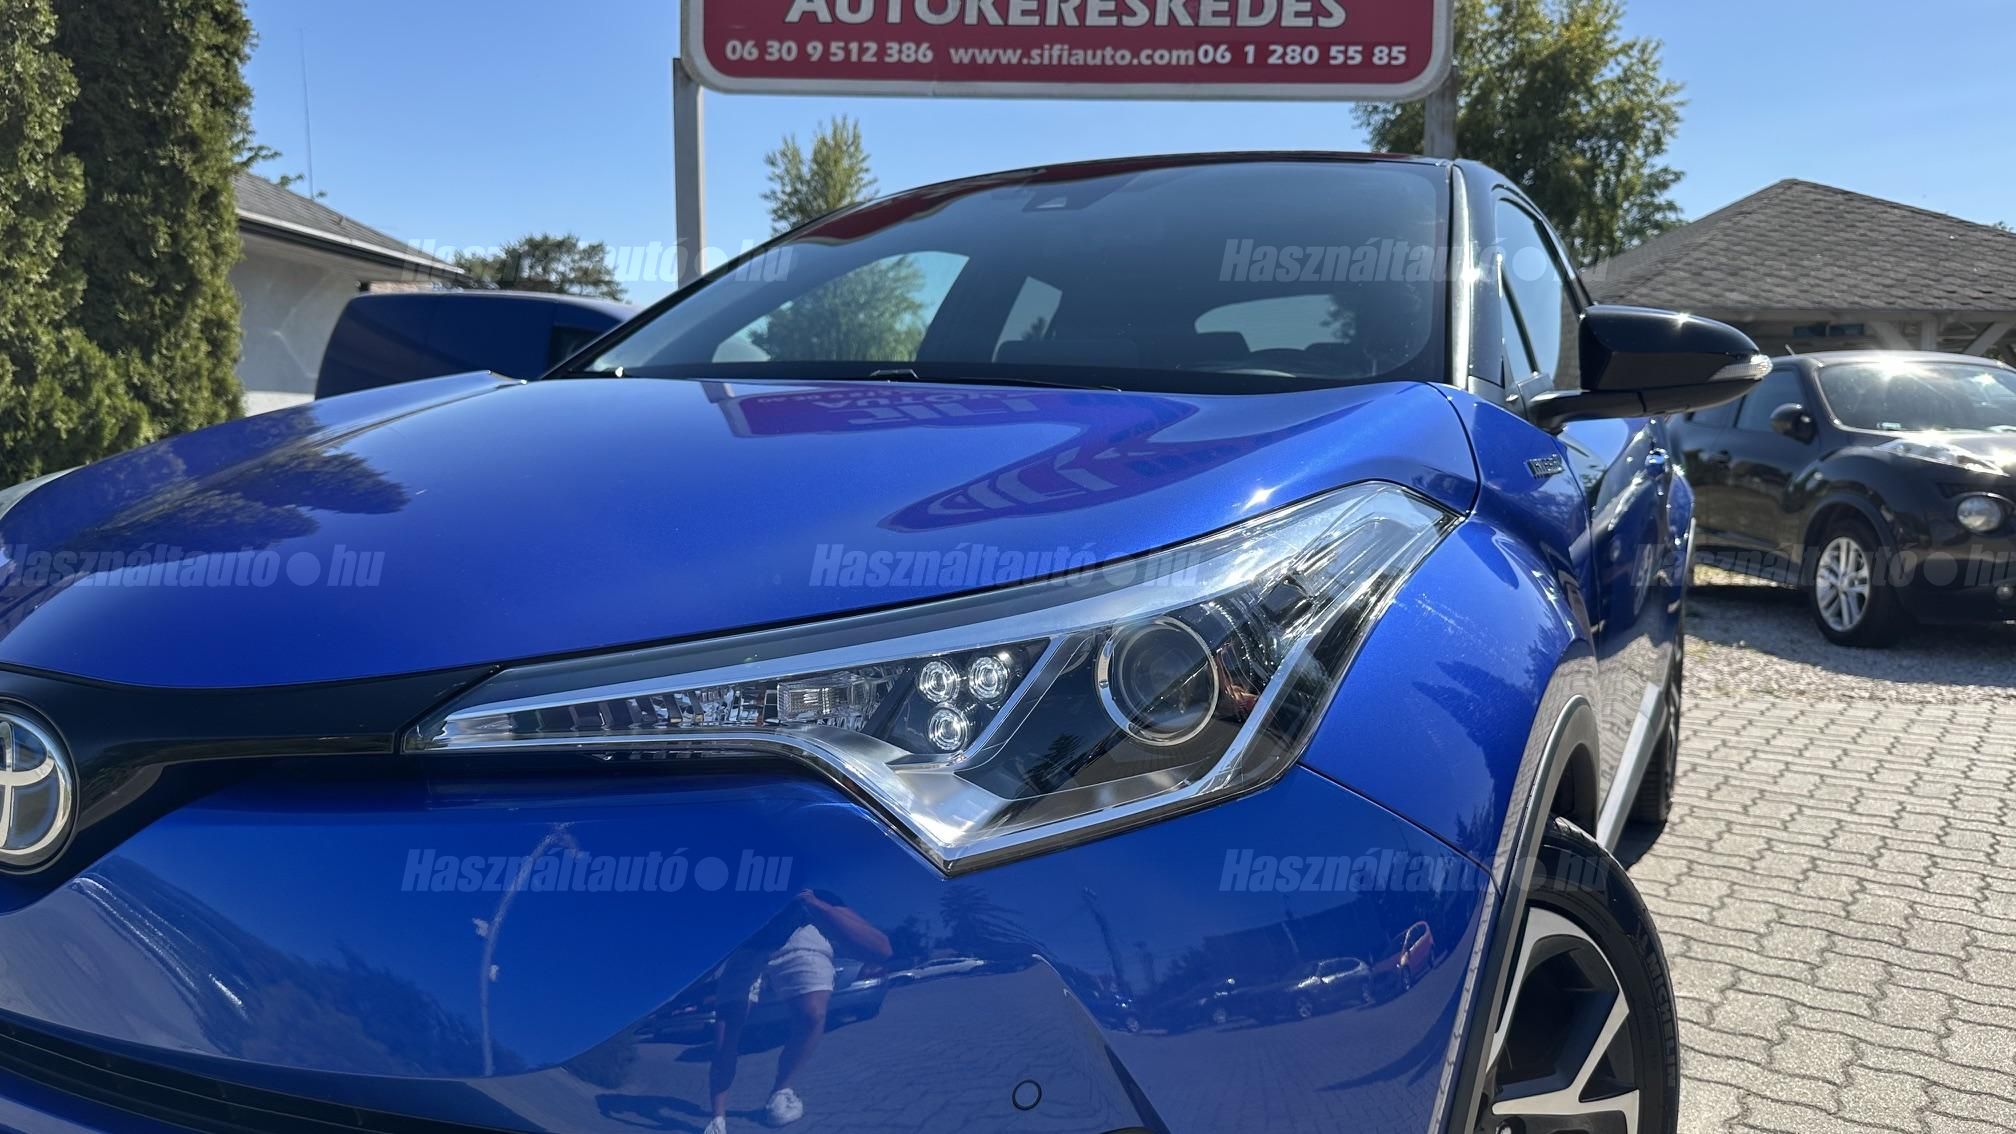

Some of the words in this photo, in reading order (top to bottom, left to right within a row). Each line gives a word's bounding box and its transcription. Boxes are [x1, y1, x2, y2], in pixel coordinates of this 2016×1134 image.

[725, 40, 759, 61] 06
[764, 41, 798, 62] 30
[806, 41, 824, 62] 9
[829, 42, 878, 62] 512
[884, 42, 934, 63] 386
[949, 44, 1195, 66] www.sifiauto.com
[1197, 44, 1232, 64] 06
[1244, 45, 1255, 64] 1
[1267, 45, 1319, 65] 280
[1329, 46, 1362, 65] 55
[1372, 46, 1407, 65] 85
[1646, 951, 1676, 1088] MICHELIN
